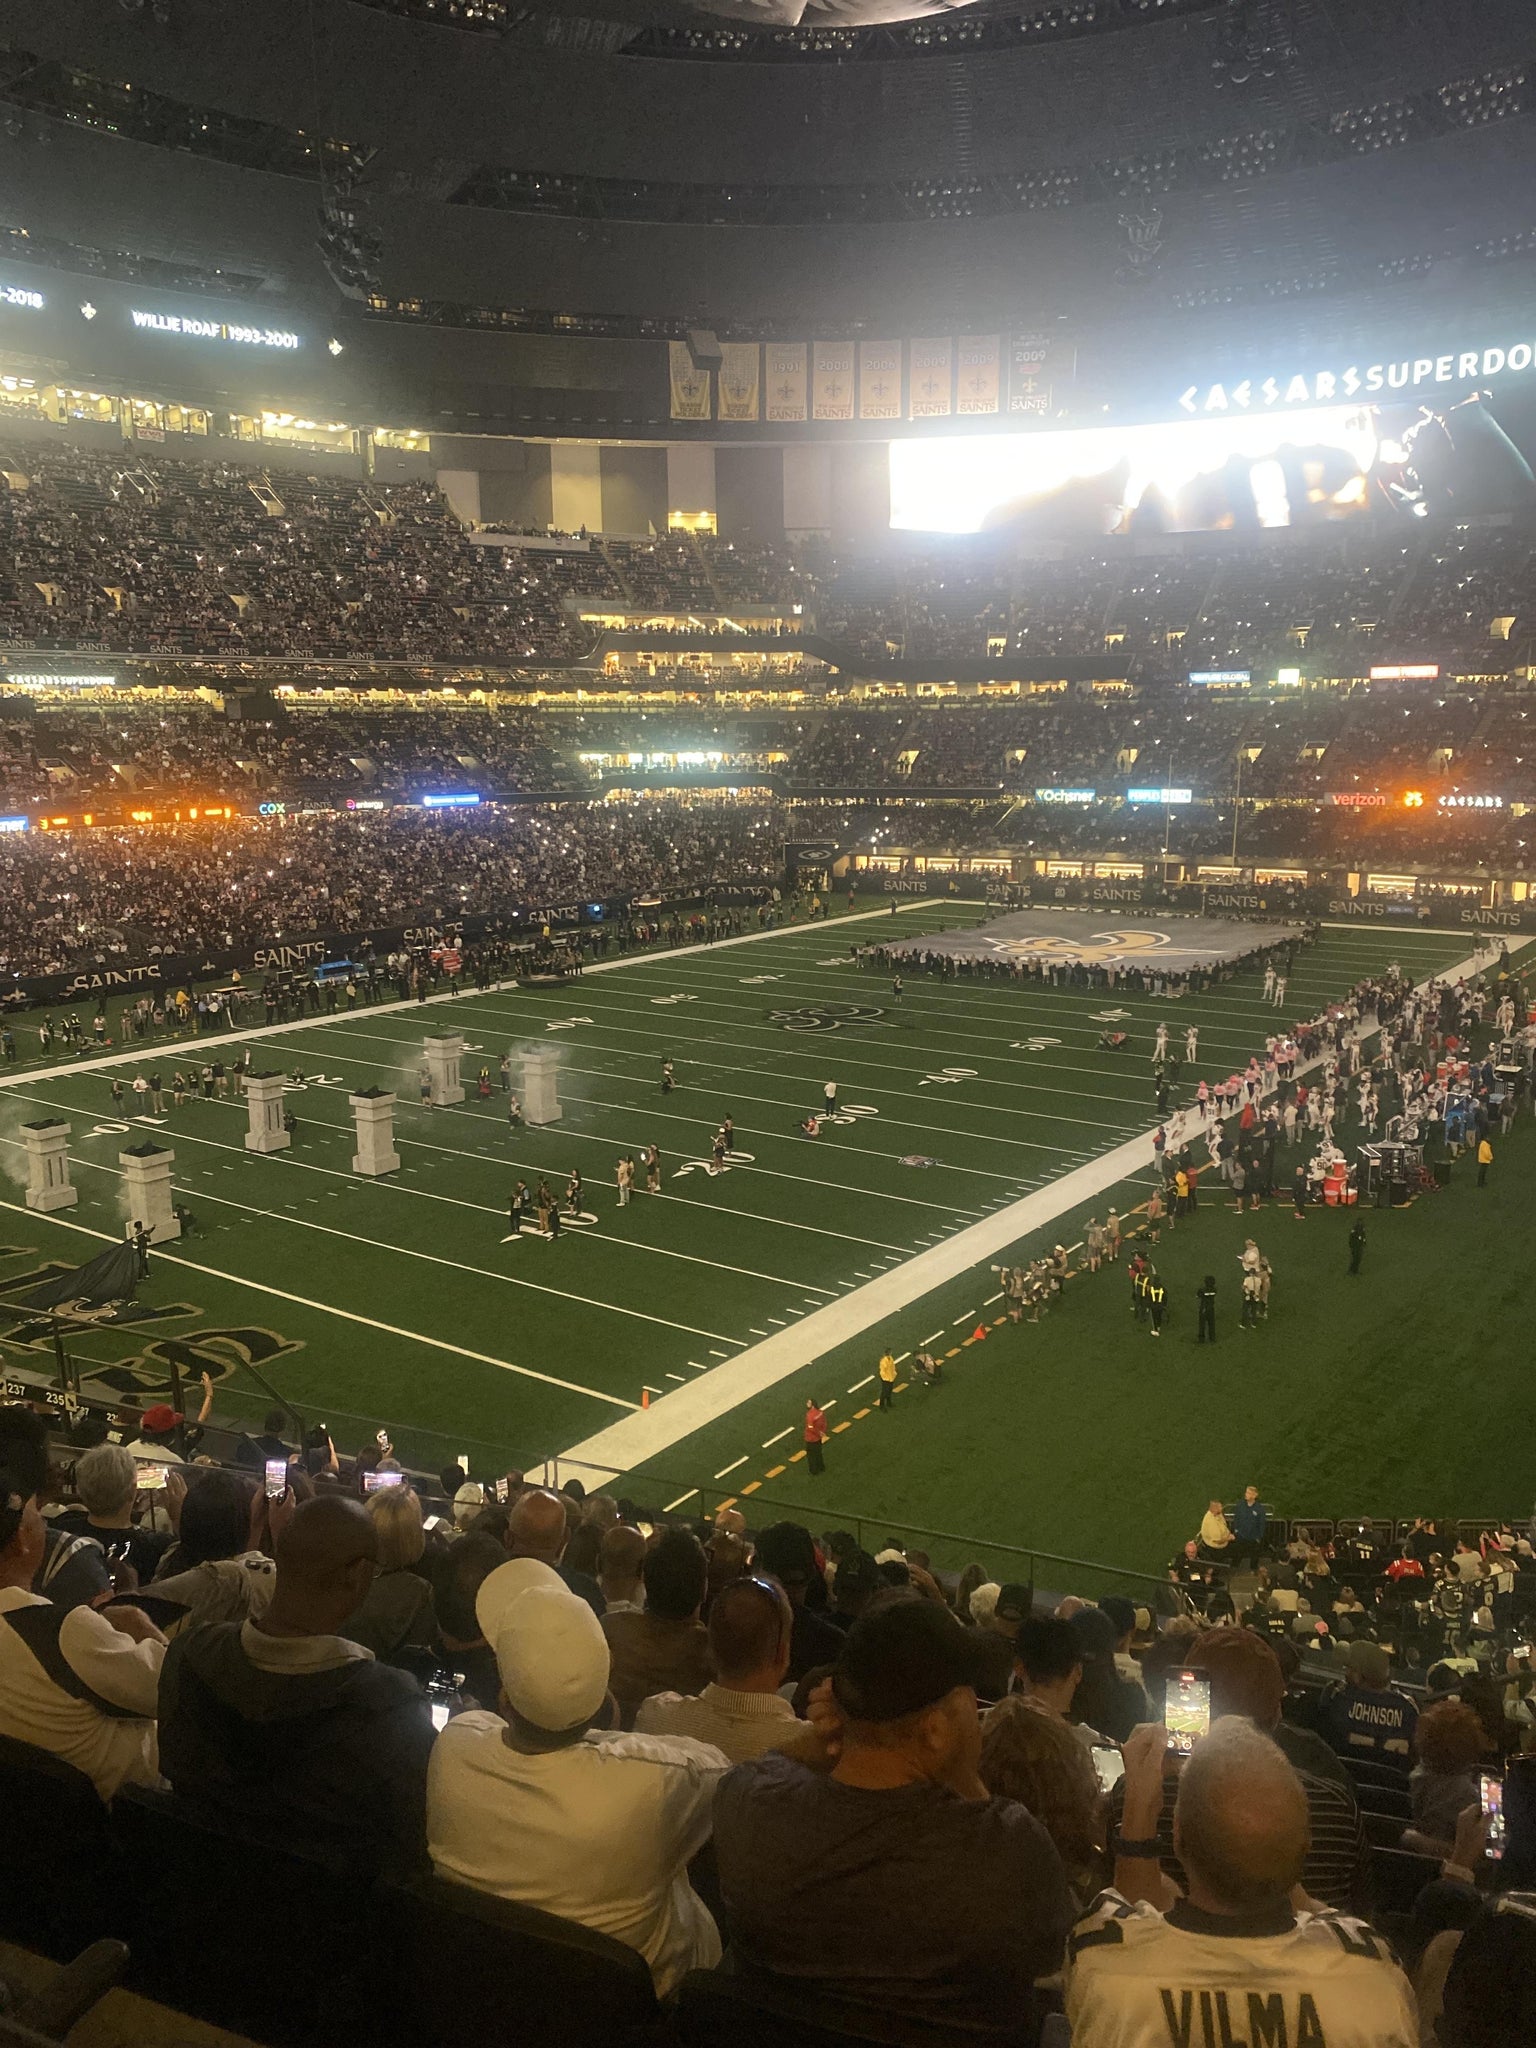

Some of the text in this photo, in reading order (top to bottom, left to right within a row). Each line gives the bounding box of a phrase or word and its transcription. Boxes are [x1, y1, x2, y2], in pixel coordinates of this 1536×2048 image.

[132, 311, 298, 348] WILLIE ROAF 1993-2001
[964, 354, 994, 365] 2009
[1015, 350, 1046, 361] 2009
[916, 356, 946, 368] 2009
[1178, 343, 1536, 413] CAESARS SUPERDO
[912, 405, 947, 415] SAINTS
[960, 402, 996, 412] SAINTS
[1011, 400, 1048, 410] SAINTS
[769, 411, 804, 420] SAINTS
[815, 409, 851, 418] SAINTS
[863, 408, 898, 418] SAINTS
[0, 640, 36, 649] SAINTS
[76, 642, 111, 651] SAINTS
[150, 645, 183, 654] SAINTS
[218, 647, 250, 656] SAINTS
[285, 649, 314, 658] SAINTS
[347, 651, 375, 660] SAINTS
[407, 653, 434, 662] SAINTS
[1043, 790, 1095, 803] Ochsner
[1333, 793, 1386, 806] verizon
[1438, 796, 1504, 808] CAESARS
[259, 803, 286, 815] COX
[304, 801, 332, 810] SAINTS
[356, 801, 384, 810] entergy
[883, 880, 927, 893] SAINTS
[1093, 888, 1142, 901] SAINTS
[1208, 894, 1258, 909] SAINTS
[1328, 900, 1385, 917] SAINTS
[1460, 909, 1521, 926] SAINTS
[254, 941, 325, 969] SAINTS
[74, 964, 161, 991] SAINTS
[7, 1383, 26, 1396] 237
[45, 1392, 65, 1406] 235
[1348, 1701, 1403, 1728] JOHNSON
[1159, 1988, 1326, 2048] VILMA
